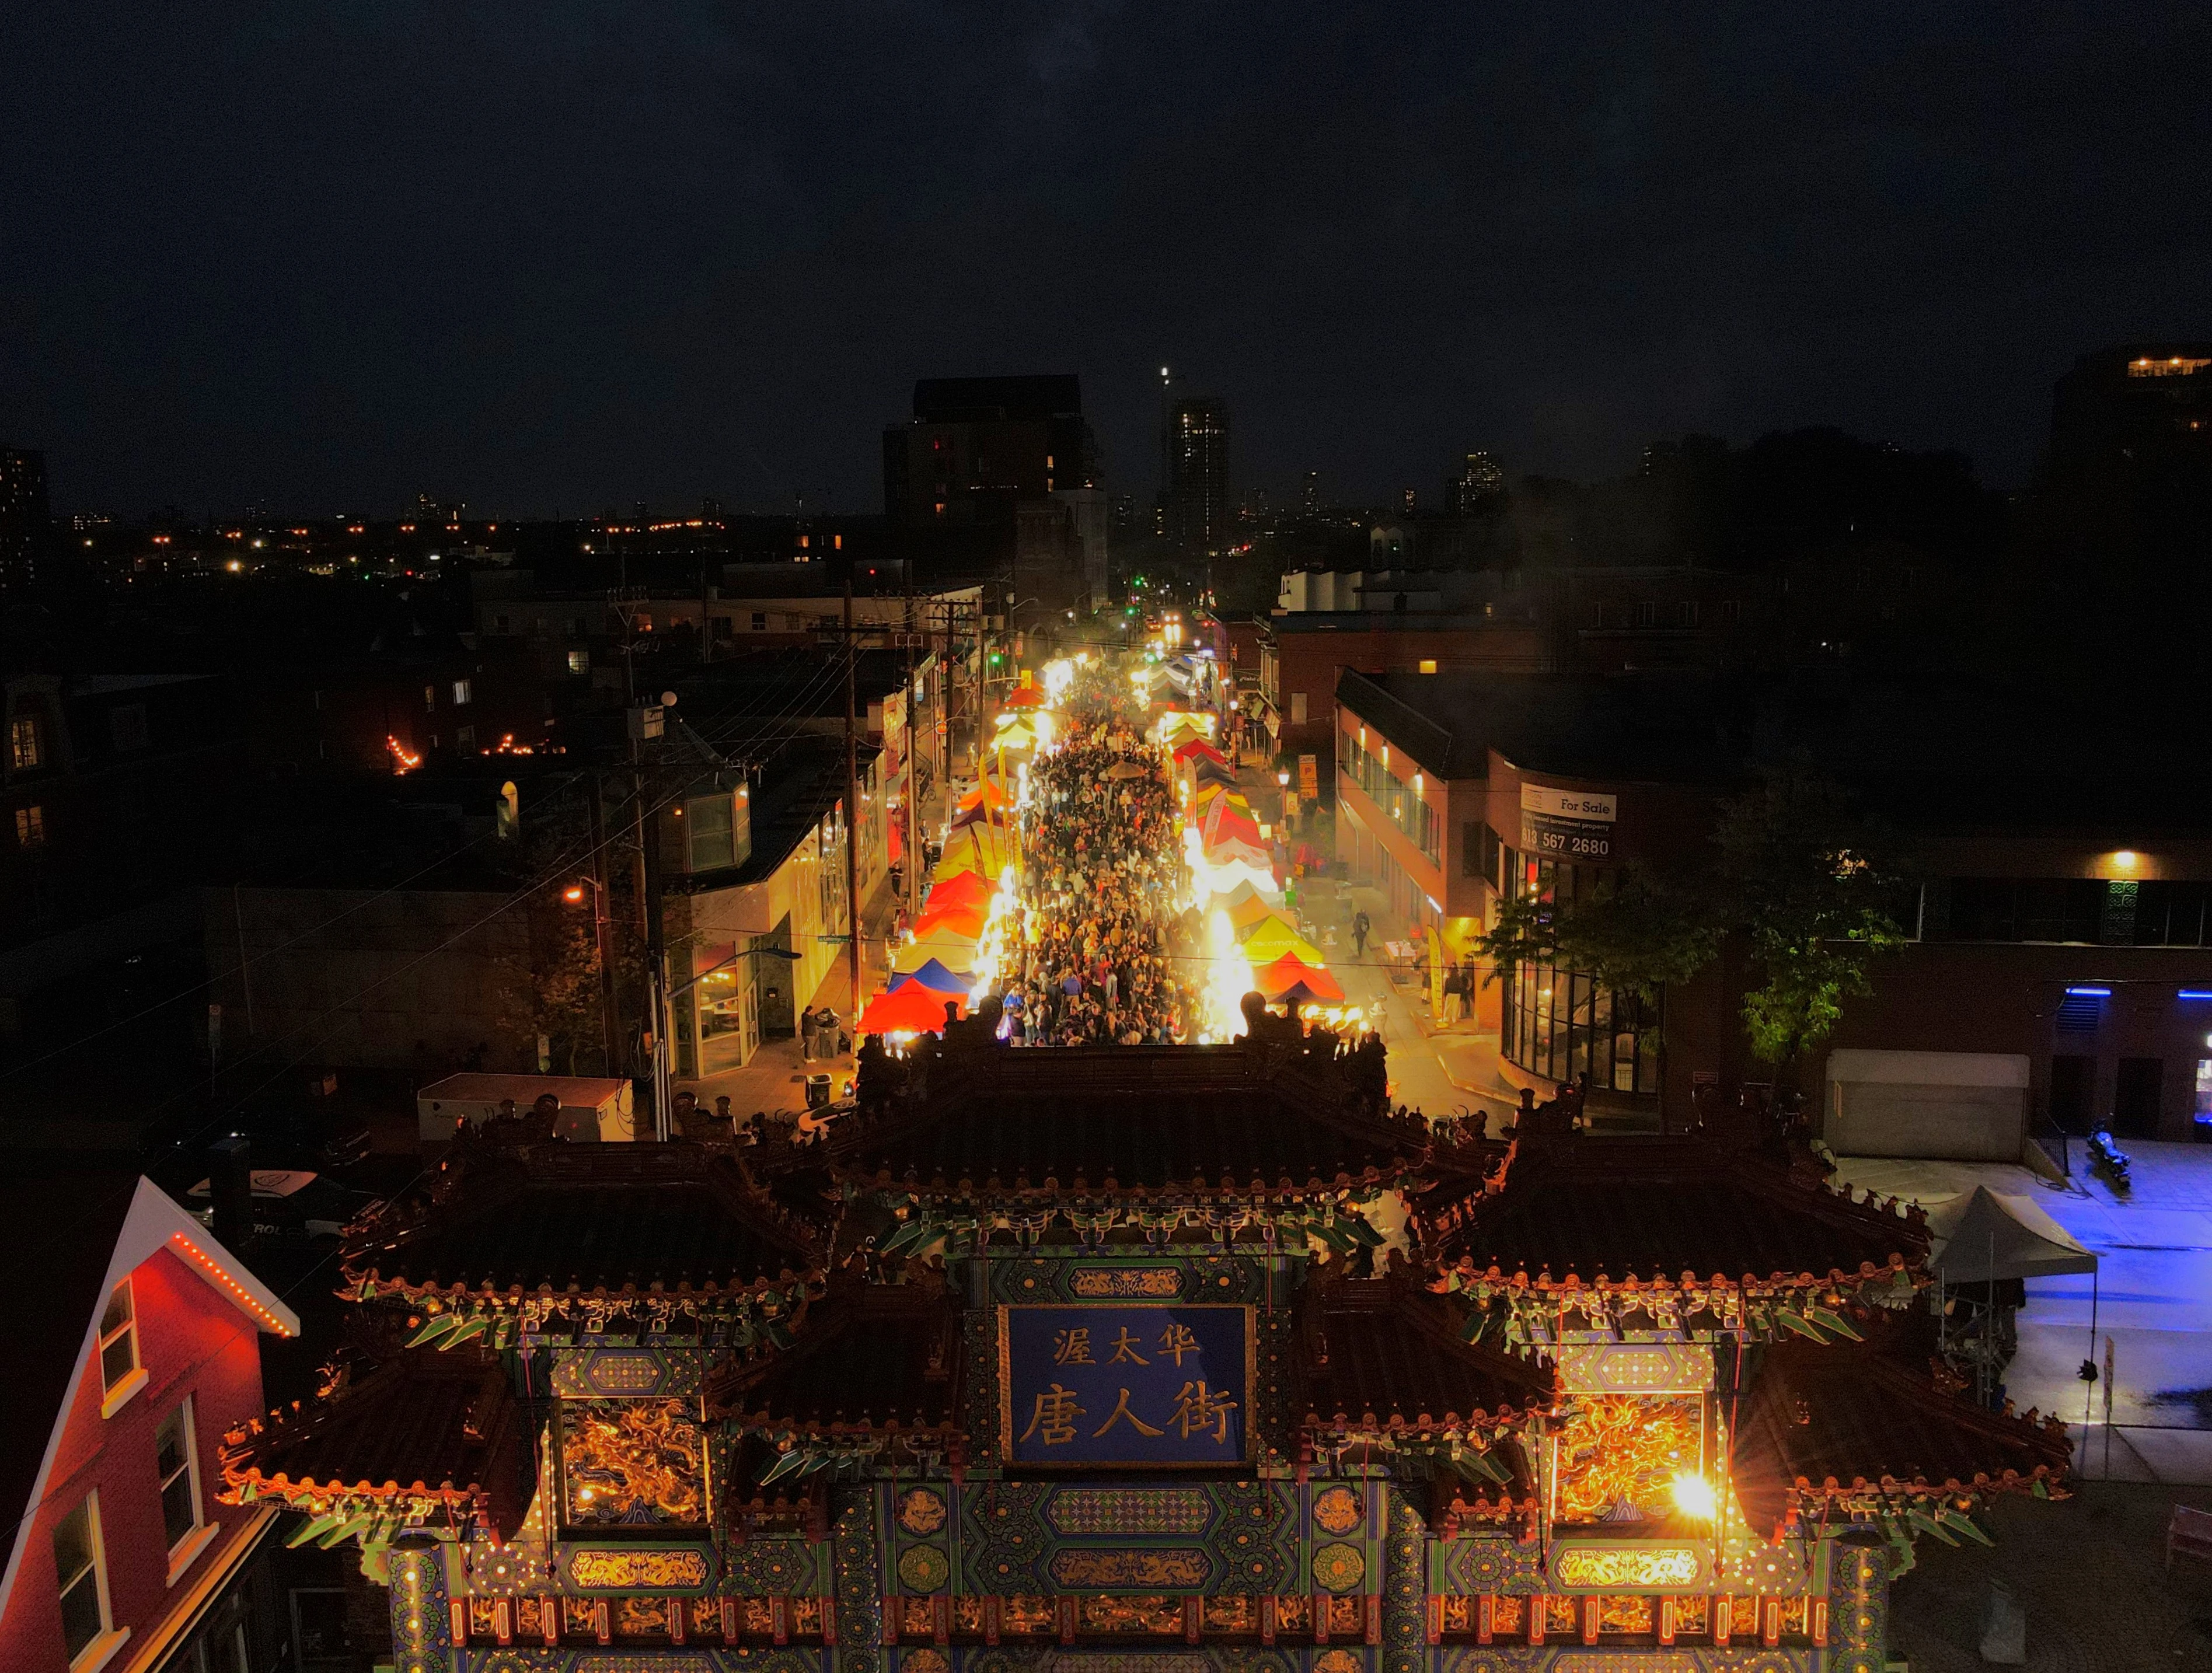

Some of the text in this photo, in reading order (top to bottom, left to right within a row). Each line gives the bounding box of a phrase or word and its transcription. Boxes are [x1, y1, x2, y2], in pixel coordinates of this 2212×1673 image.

[1561, 799, 1610, 814] For Sale
[1550, 818, 1581, 827] investment
[1582, 823, 1610, 832] property
[1521, 827, 1538, 844] 613
[1543, 832, 1565, 850] 567
[1571, 837, 1609, 855] 2680
[253, 1223, 282, 1235] ROL
[1052, 1323, 1201, 1368] 渥太华
[1018, 1379, 1238, 1445] 唐人街
